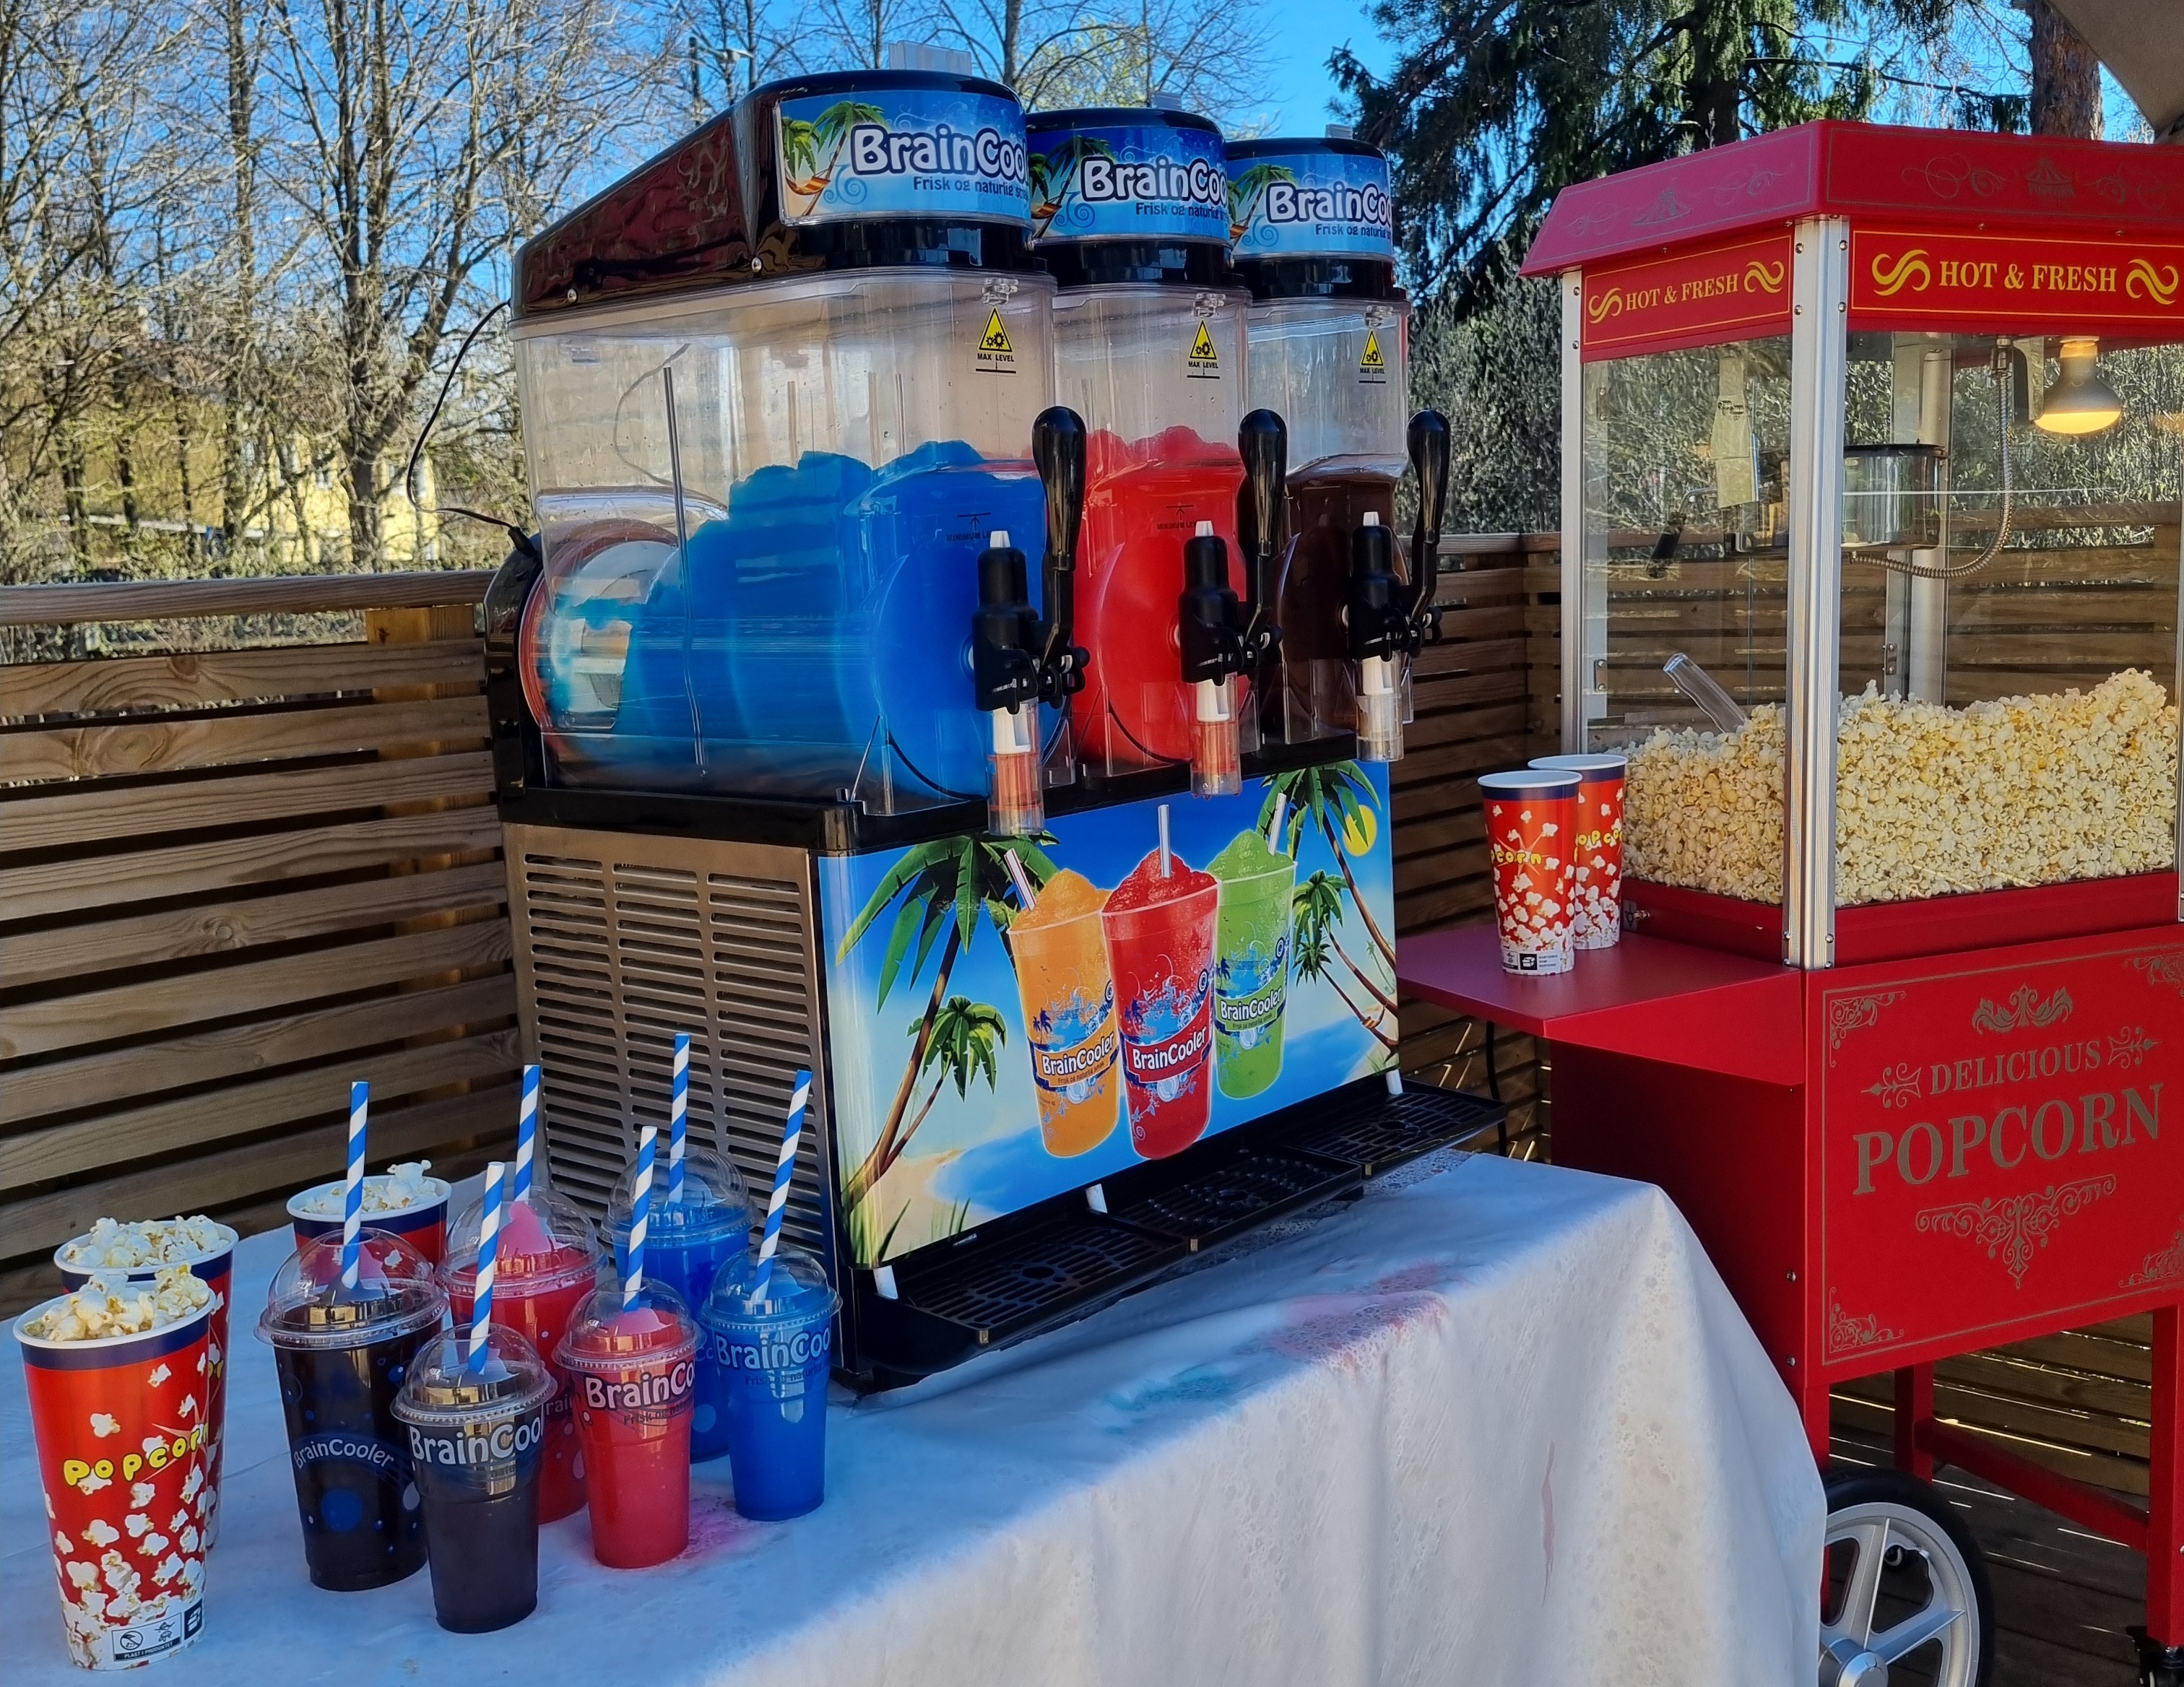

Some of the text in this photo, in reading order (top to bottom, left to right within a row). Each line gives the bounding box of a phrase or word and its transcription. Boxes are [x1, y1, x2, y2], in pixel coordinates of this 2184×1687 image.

[913, 175, 950, 191] Frisk
[955, 180, 970, 191] og
[975, 181, 1013, 196] naturlig
[1135, 202, 1168, 216] Frisk
[1171, 205, 1185, 216] og
[1315, 223, 1343, 235] Frisk
[1346, 225, 1358, 236] og
[1626, 273, 1739, 311] HOT & FRESH
[1938, 261, 2118, 292] HOT & FRESH
[977, 352, 992, 361] MAX
[1220, 985, 1282, 1022] BrainCooler
[1041, 1031, 1114, 1076] BrainCooler
[1132, 1025, 1207, 1070] BrainCooler
[1929, 1039, 2102, 1096] DELICIOUS
[1852, 1083, 2164, 1196] POPCORN
[293, 1439, 394, 1470] BrainCooler
[409, 1416, 541, 1465] BrainCoo
